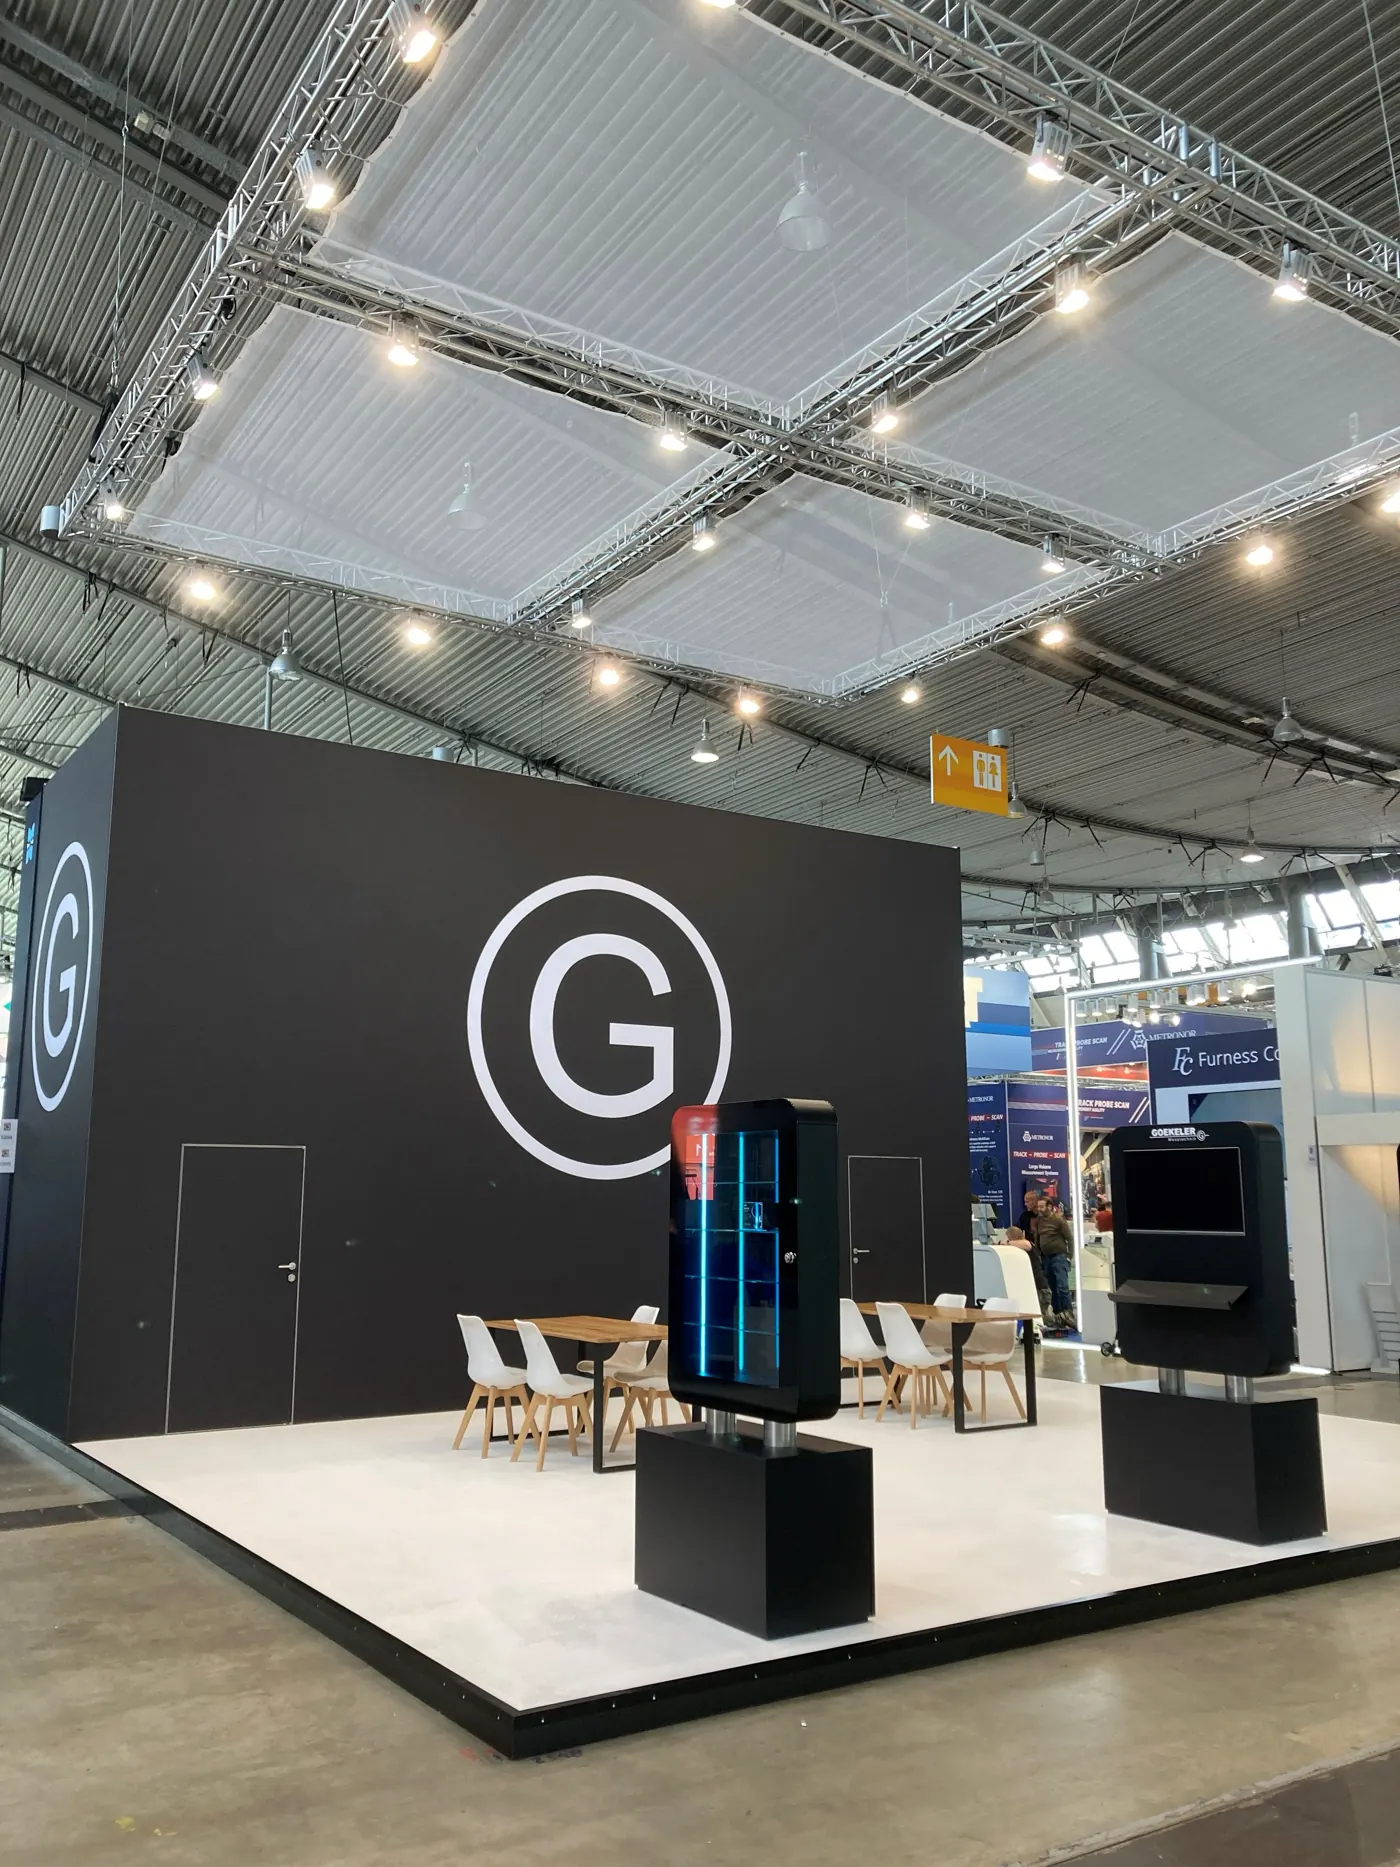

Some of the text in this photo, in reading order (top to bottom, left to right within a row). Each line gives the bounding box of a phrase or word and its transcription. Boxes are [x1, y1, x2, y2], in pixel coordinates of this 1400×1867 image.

[43, 892, 79, 1058] G
[529, 932, 674, 1119] G
[1092, 1036, 1107, 1045] SCAN
[1198, 1050, 1259, 1067] Furness
[1095, 1100, 1114, 1108] PROBE
[1114, 1101, 1130, 1109] SCAN
[1151, 1127, 1196, 1137] GOEKELER
